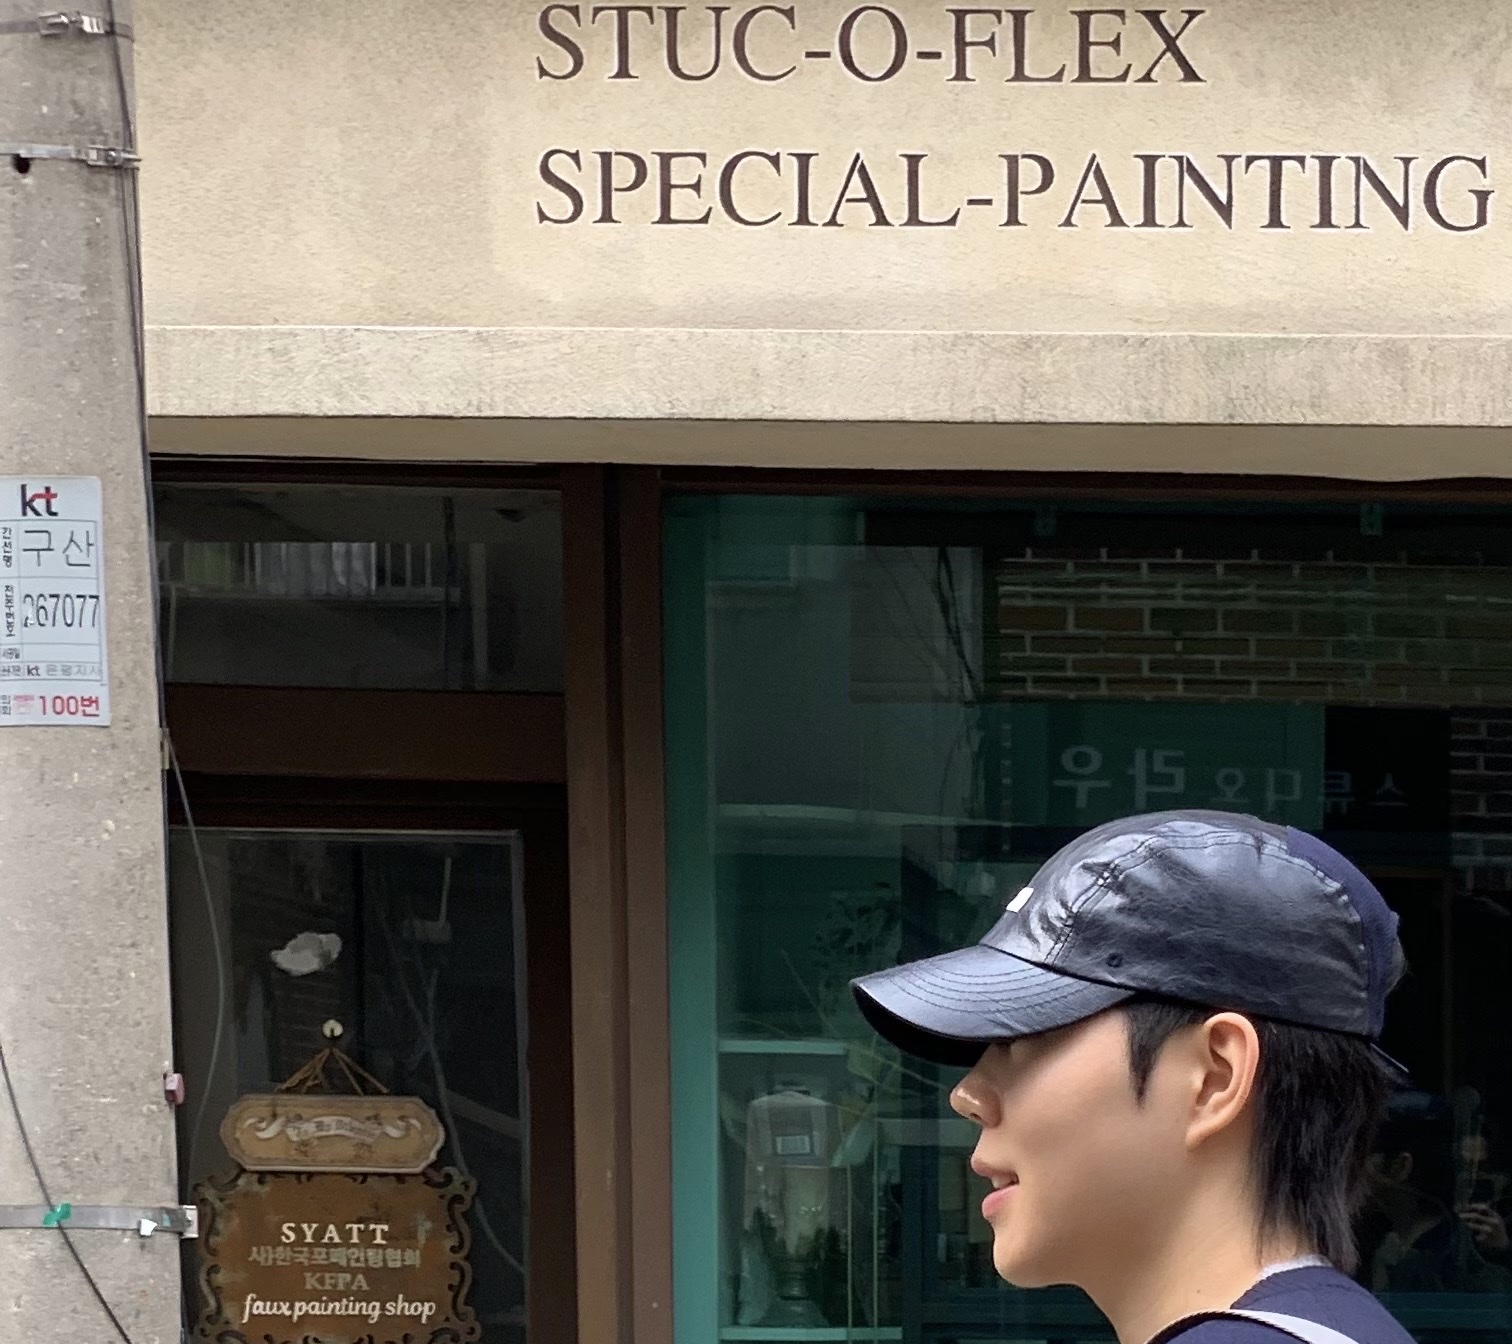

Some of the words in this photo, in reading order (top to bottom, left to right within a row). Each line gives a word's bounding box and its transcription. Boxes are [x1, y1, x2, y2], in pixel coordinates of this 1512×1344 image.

[535, 3, 1207, 84] STUC-O-FLEX
[535, 149, 1496, 233] SPECIAL-PAINTING
[20, 484, 59, 517] kt
[22, 530, 95, 567] 구산
[38, 694, 100, 718] 100번
[281, 1223, 389, 1245] SYATT
[241, 1293, 292, 1324] faux
[292, 1296, 381, 1324] painting
[384, 1294, 436, 1324] shop
